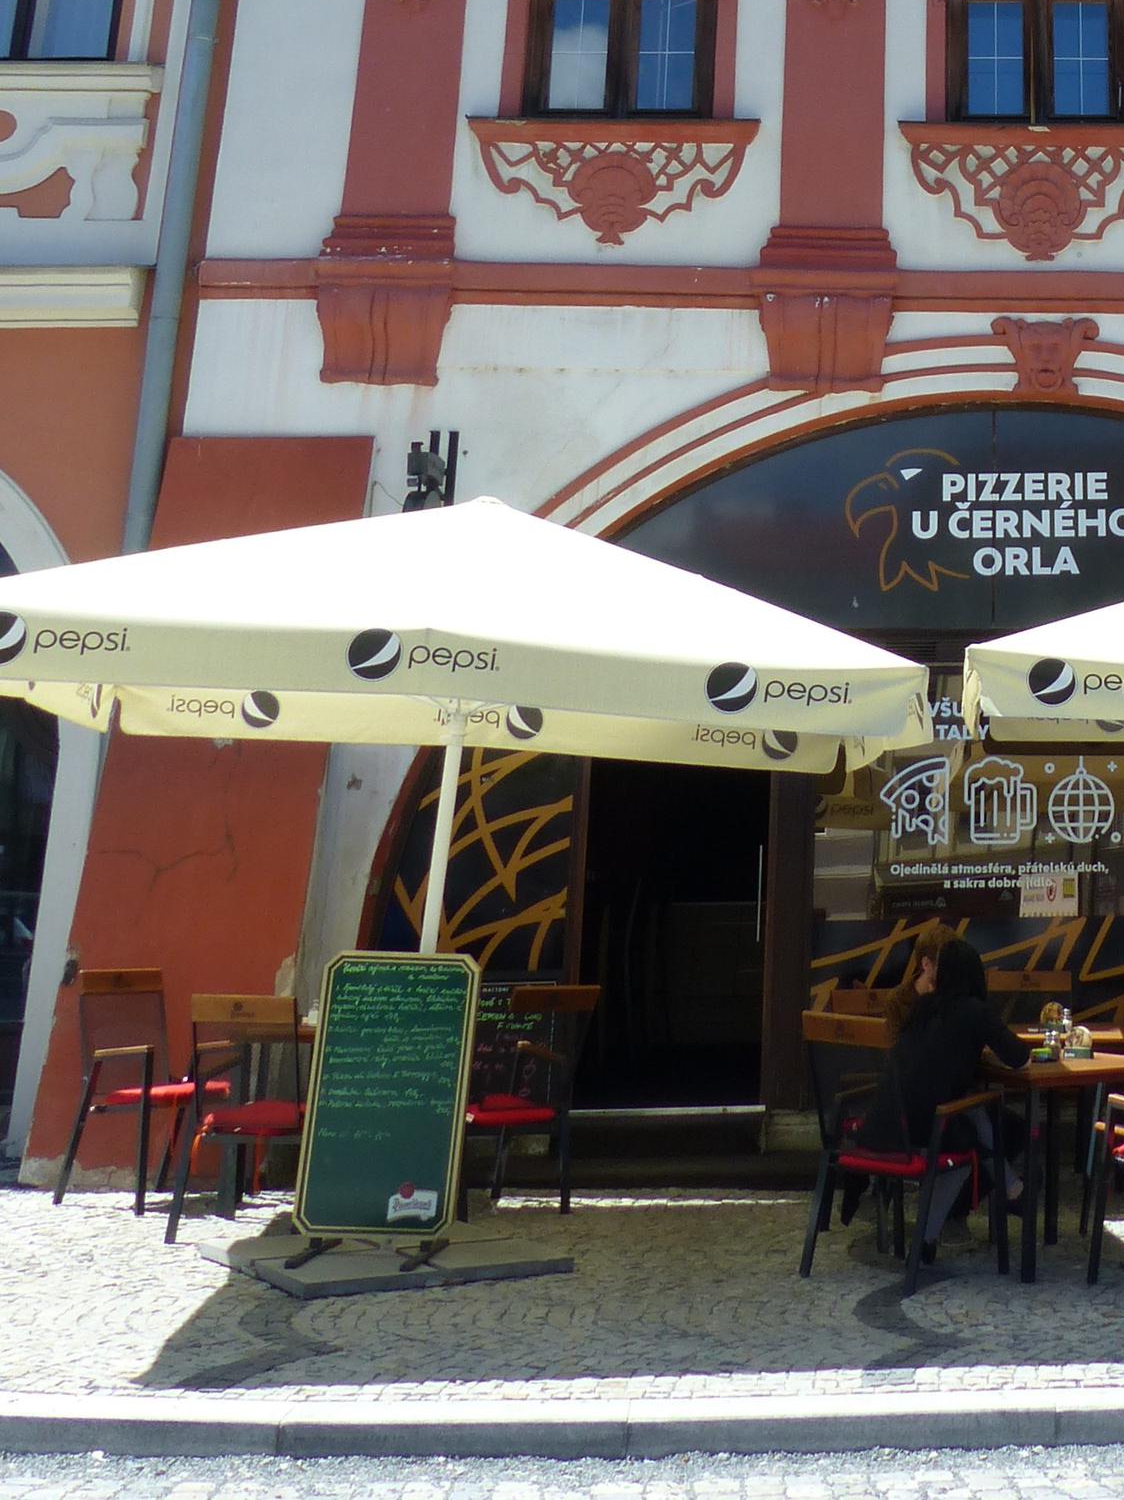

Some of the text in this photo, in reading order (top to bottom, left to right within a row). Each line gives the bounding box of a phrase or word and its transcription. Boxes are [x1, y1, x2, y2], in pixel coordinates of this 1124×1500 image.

[942, 472, 1108, 501] PIZZERIE
[912, 510, 938, 539] U
[973, 546, 1080, 576] ORLA
[34, 627, 127, 655] pepsi
[409, 645, 497, 672] pepsi
[764, 680, 850, 706] pepsi
[890, 862, 949, 877] Ojedinělá
[951, 862, 1016, 876] atmosféra,
[1077, 861, 1109, 875] duch,
[943, 880, 950, 889] a
[953, 878, 986, 889] sakra
